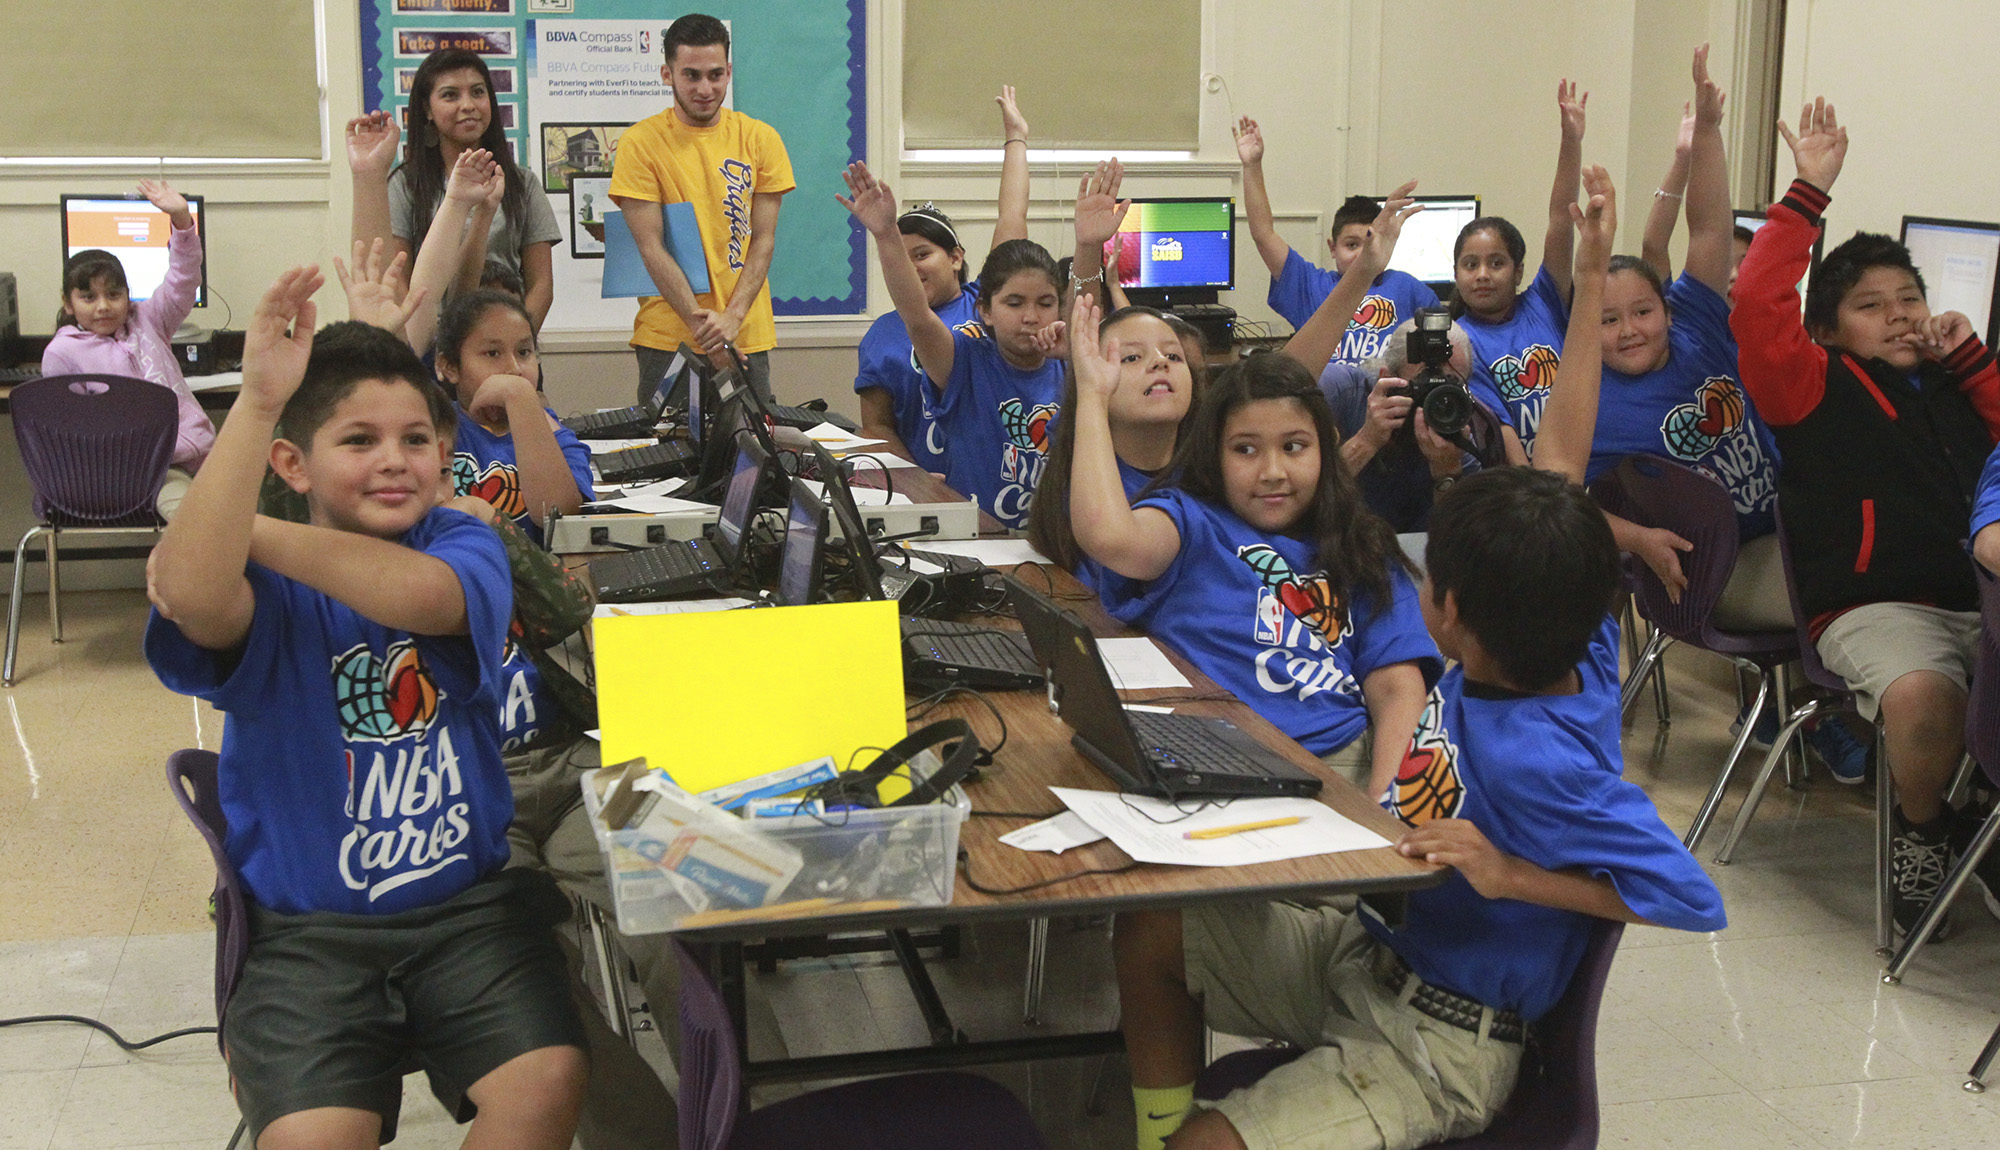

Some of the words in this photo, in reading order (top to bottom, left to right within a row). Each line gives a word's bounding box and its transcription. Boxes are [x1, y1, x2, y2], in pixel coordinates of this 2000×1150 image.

[400, 36, 435, 50] Take
[440, 39, 449, 50] a
[454, 38, 490, 50] seat.
[546, 31, 577, 42] BBVA
[580, 31, 633, 44] Compass
[586, 45, 612, 53] Official
[614, 45, 633, 53] Bank
[547, 62, 577, 73] BBVA
[580, 62, 630, 74] Compass
[633, 62, 660, 73] Futur
[564, 89, 587, 97] certify
[1257, 631, 1273, 641] NBA
[1255, 648, 1364, 696] Care
[357, 725, 463, 821] NBA
[338, 802, 470, 890] Cares
